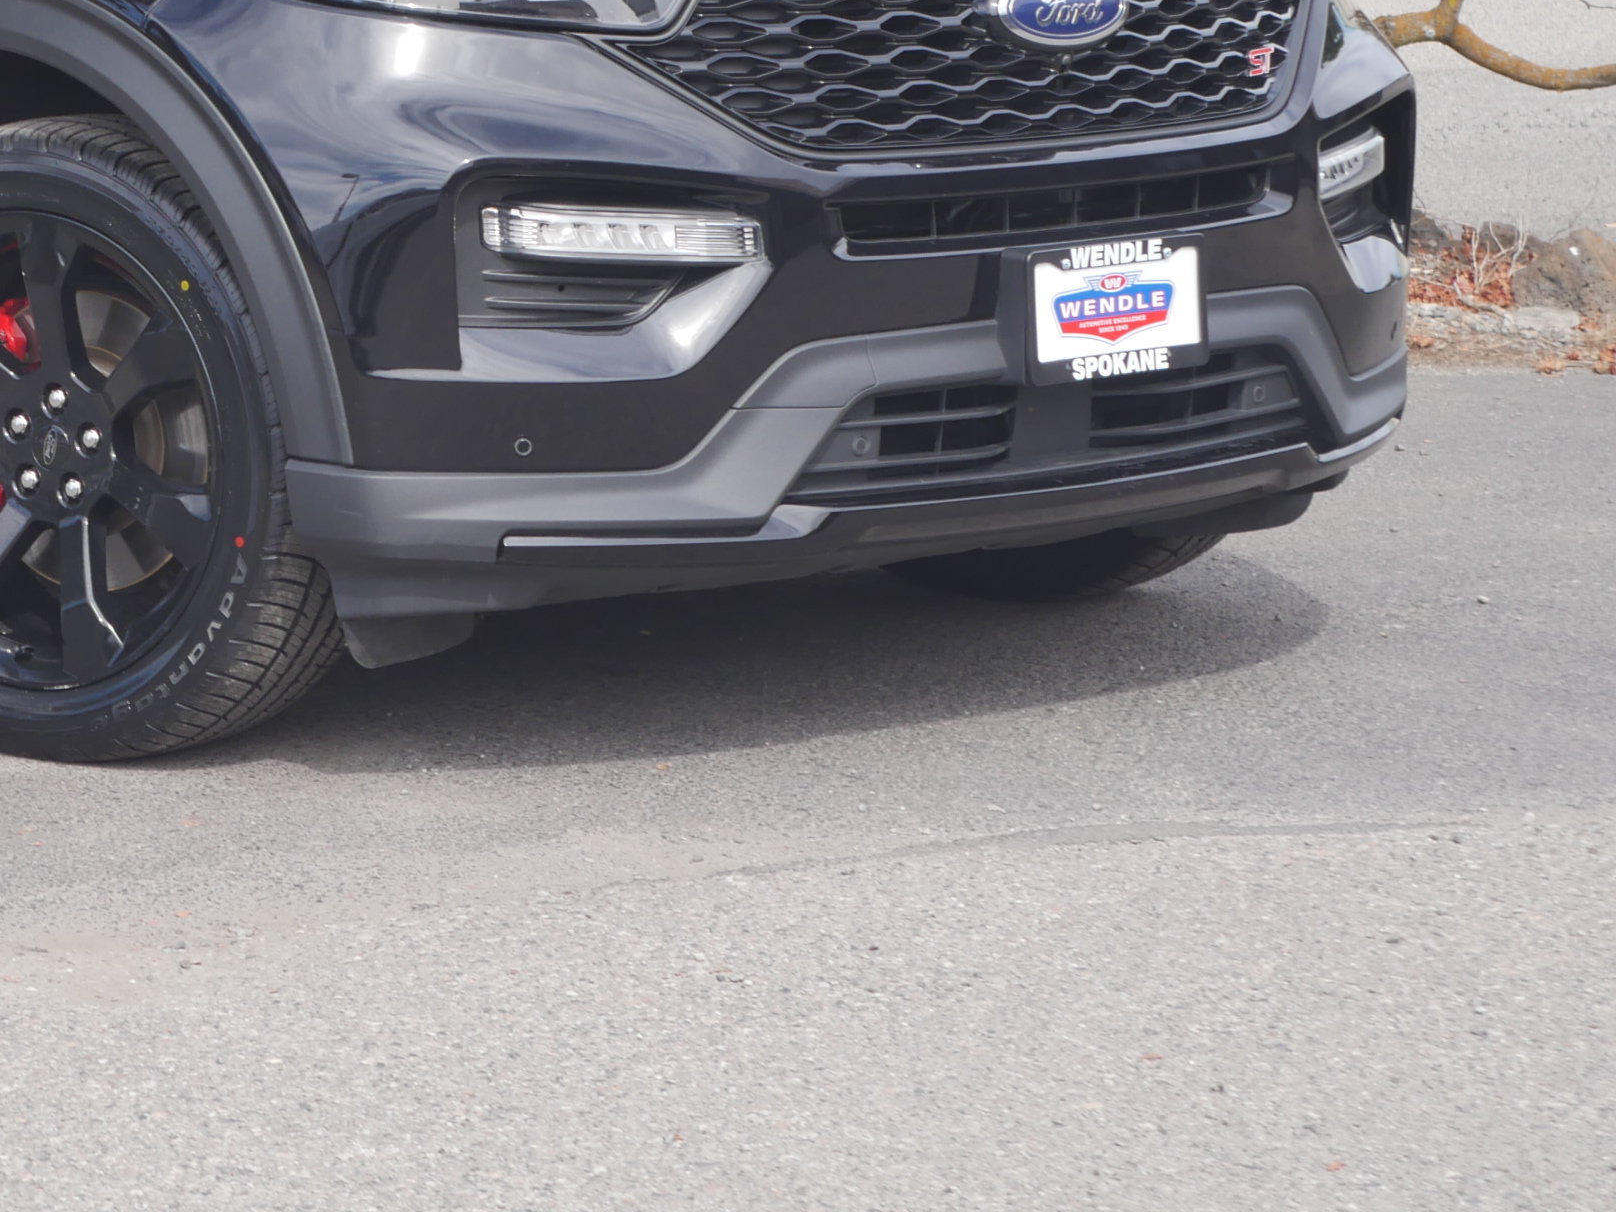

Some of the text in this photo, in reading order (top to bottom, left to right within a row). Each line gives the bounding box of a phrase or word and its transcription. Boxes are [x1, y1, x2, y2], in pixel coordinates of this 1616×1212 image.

[1247, 46, 1275, 77] ST
[1070, 238, 1163, 269] WENDLE
[1059, 290, 1166, 319] WENDLE
[1072, 347, 1170, 381] SPOKANE
